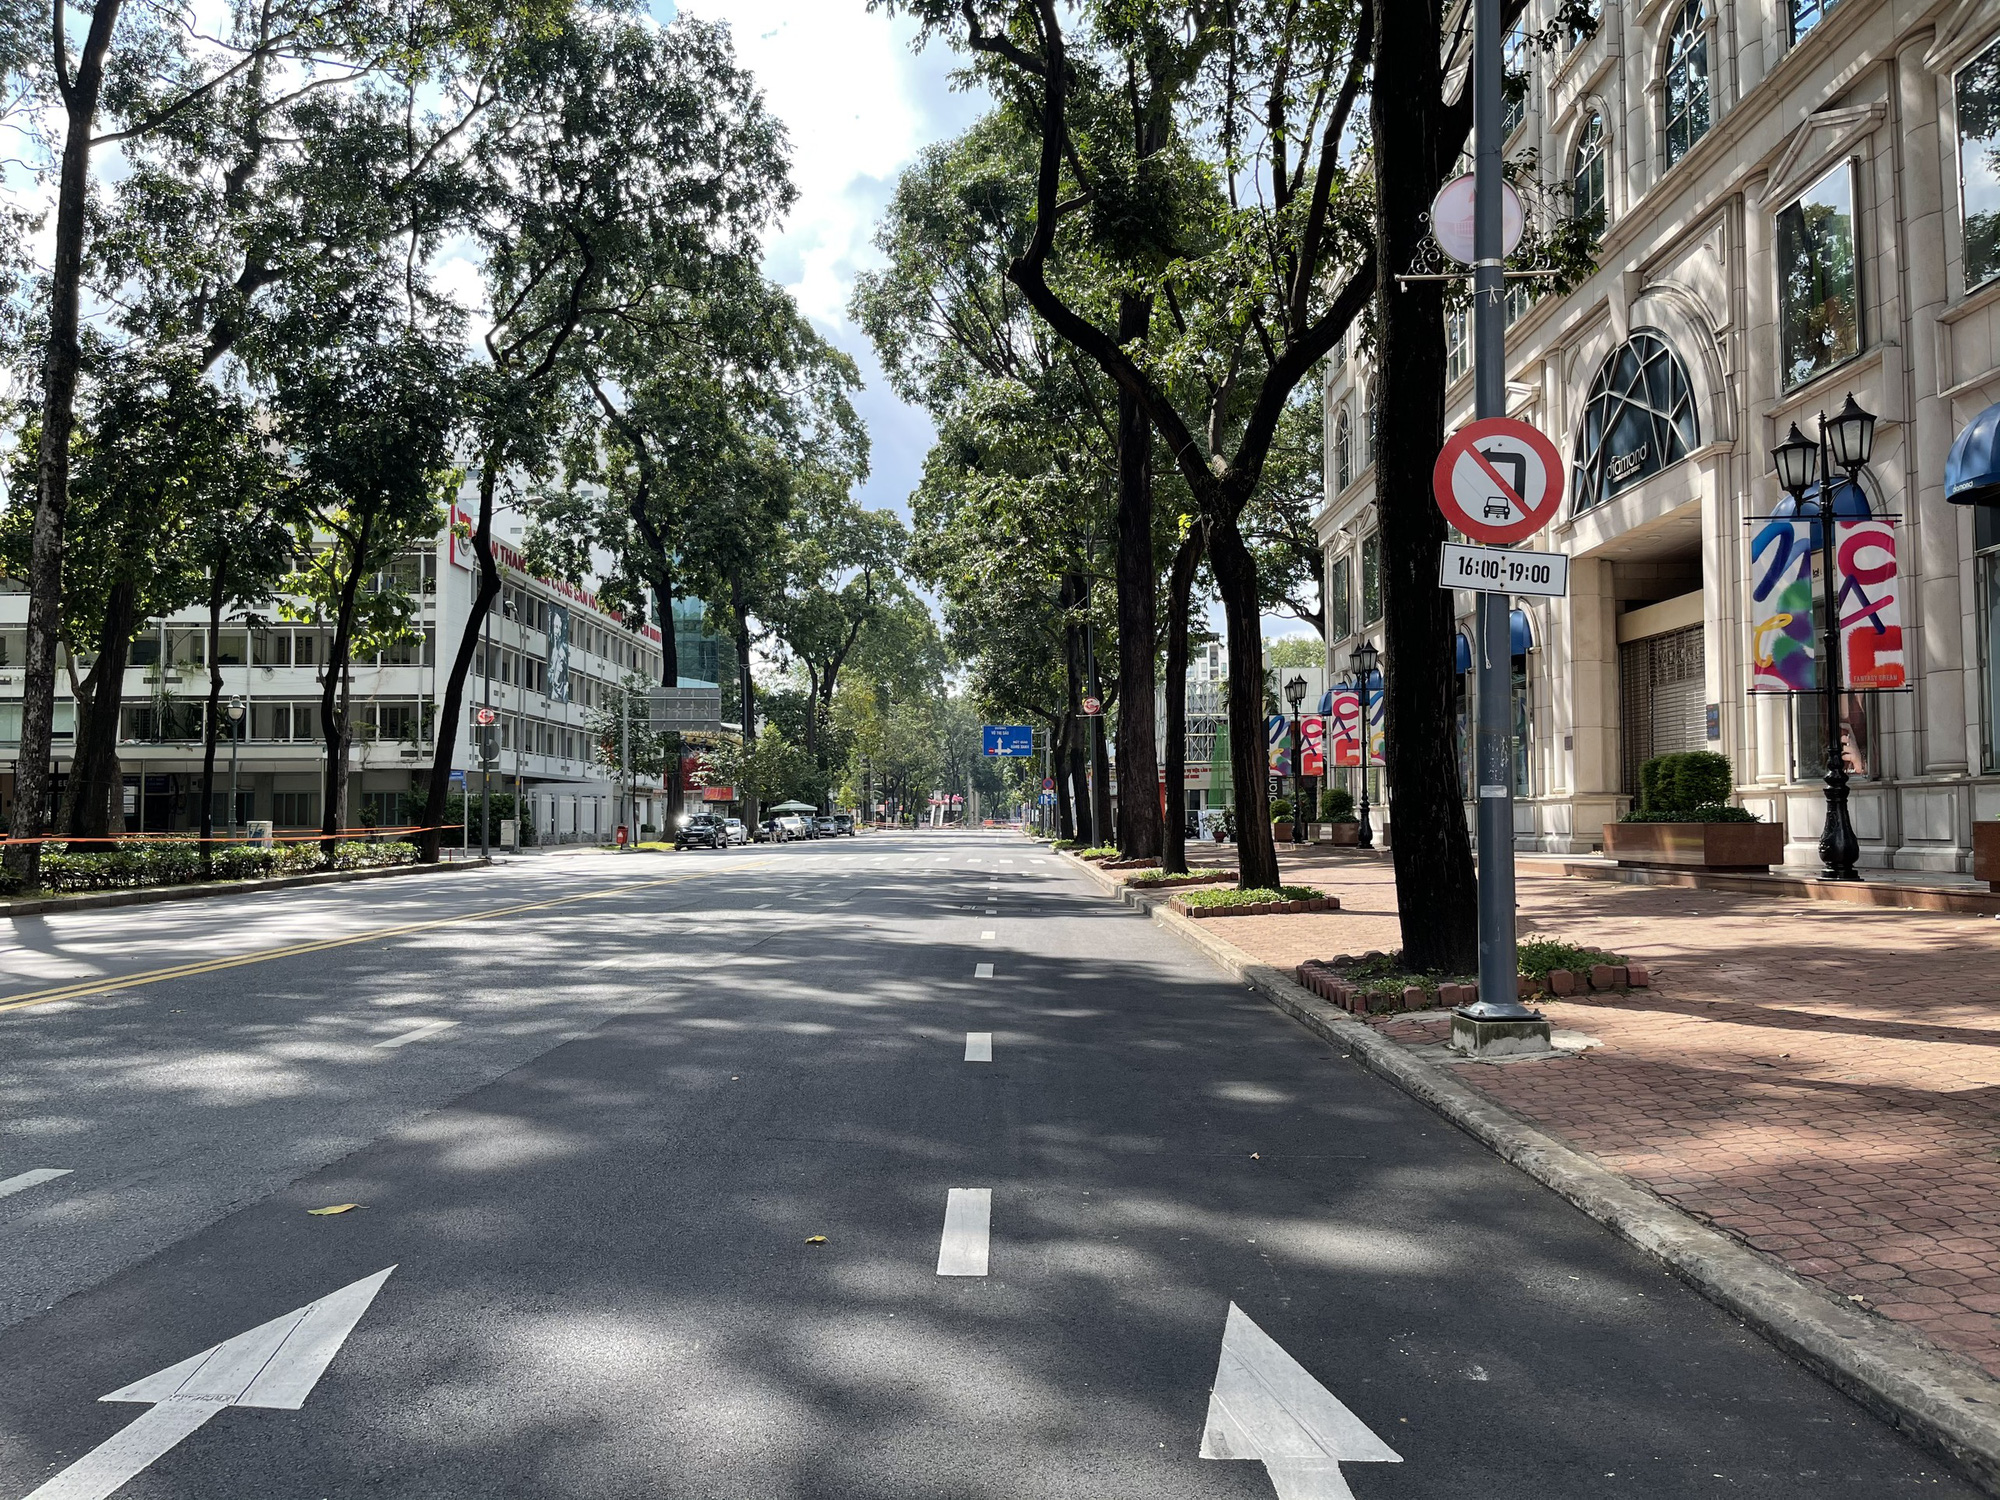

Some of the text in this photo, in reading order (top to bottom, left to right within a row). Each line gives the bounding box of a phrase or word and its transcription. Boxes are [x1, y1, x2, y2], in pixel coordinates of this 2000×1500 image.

[1606, 441, 1647, 480] diamond
[1953, 480, 1974, 493] diamond
[1458, 555, 1551, 584] 16:00-19:00
[1853, 674, 1878, 683] FANTASY
